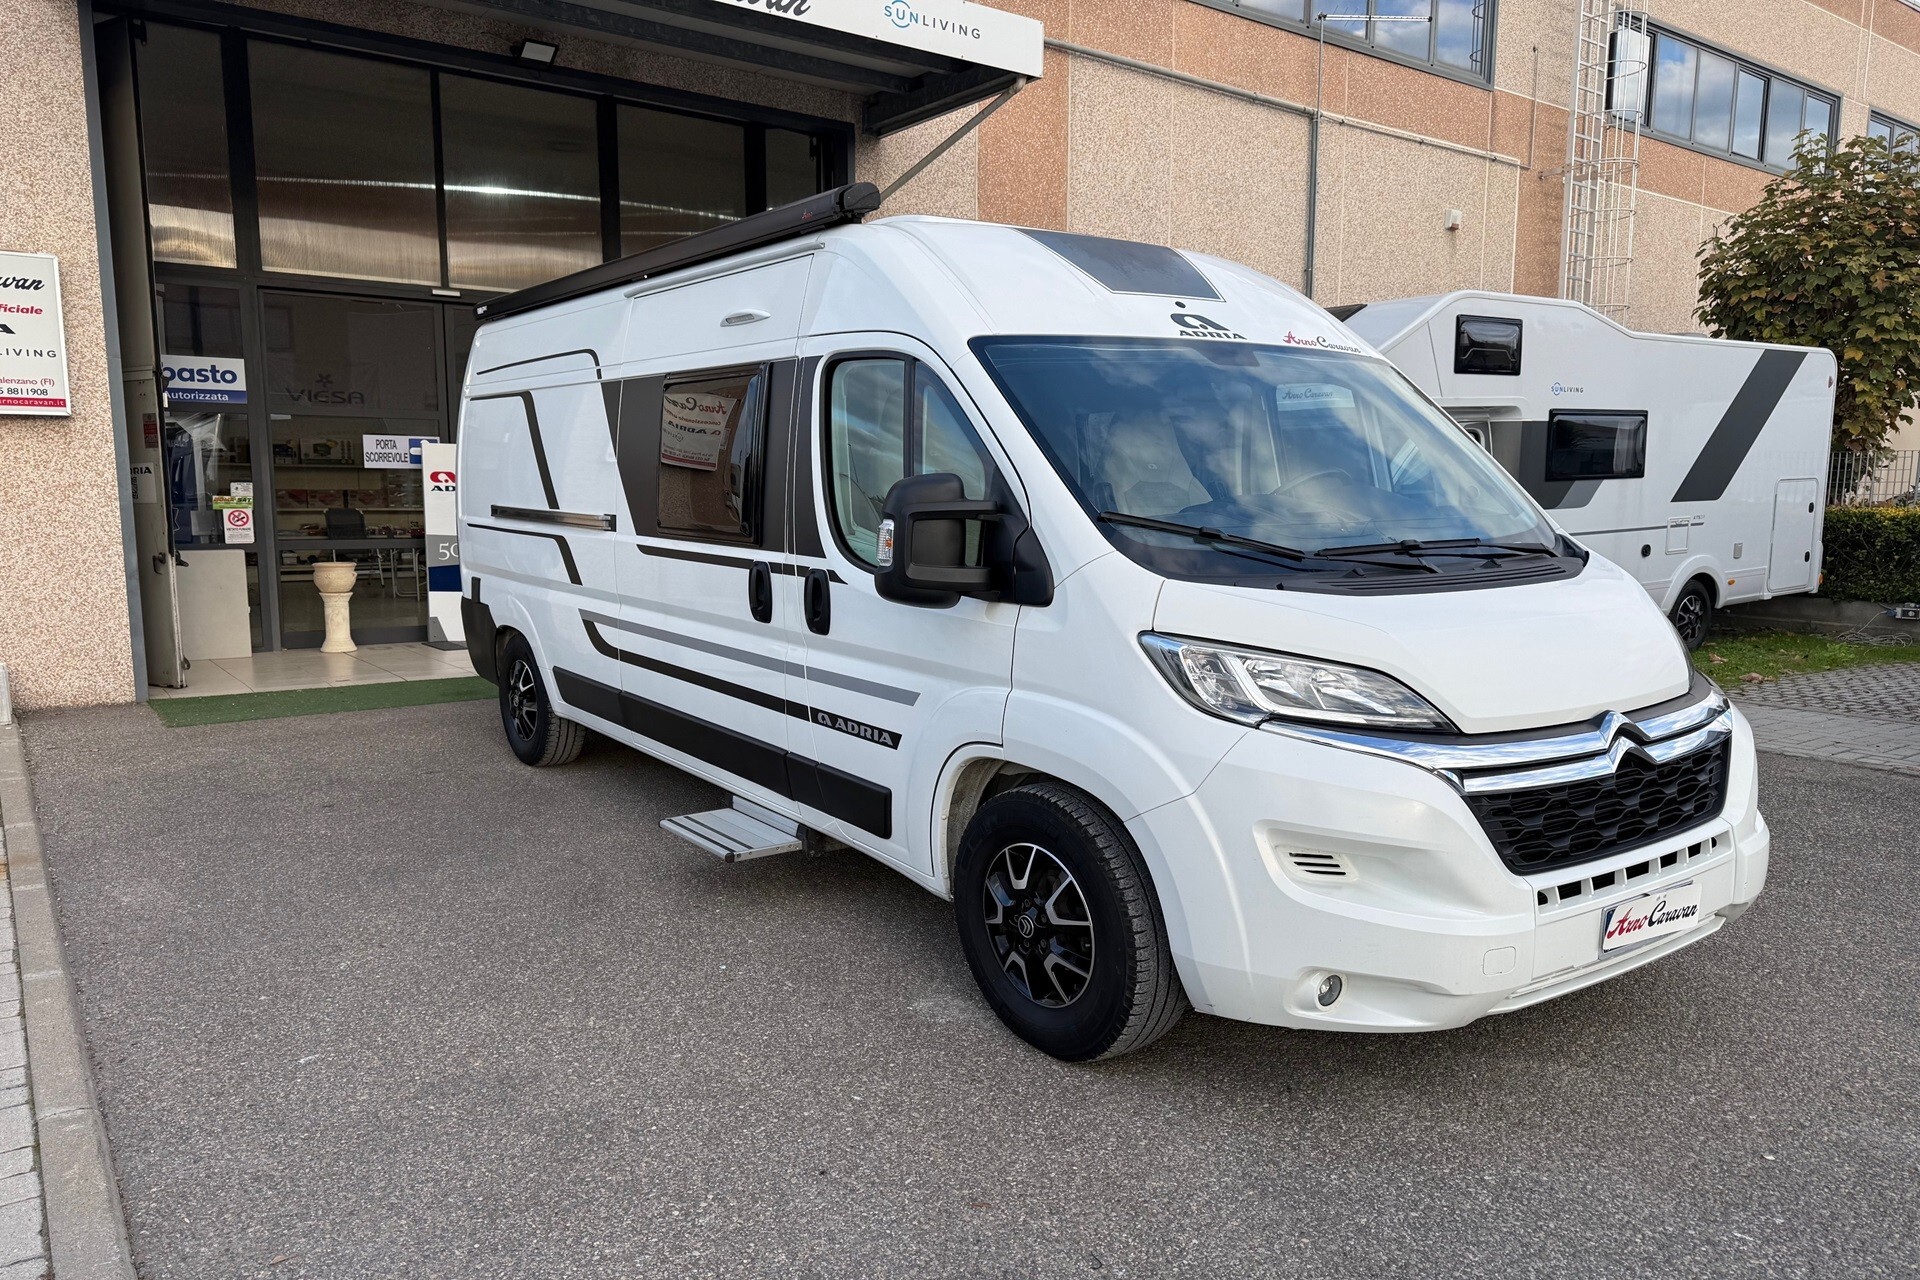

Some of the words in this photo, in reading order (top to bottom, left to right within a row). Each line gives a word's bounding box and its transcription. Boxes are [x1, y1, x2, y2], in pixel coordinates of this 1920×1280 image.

[884, 5, 981, 39] SUNLIVING
[0, 276, 45, 290] van
[1179, 330, 1248, 340] ADRIA
[1283, 331, 1317, 347] Arno
[1316, 336, 1361, 353] Caravan
[0, 348, 57, 358] IVING
[40, 378, 55, 387] (FI)
[7, 387, 48, 396] 8811908
[1551, 384, 1584, 394] SUNLIVING
[165, 391, 229, 401] Autorizzata
[285, 387, 365, 404] VIESA
[376, 439, 397, 450] PORTA
[365, 452, 408, 463] SCORREVOLE
[835, 718, 893, 746] ADRIA
[1607, 907, 1649, 939] Arno
[1648, 900, 1698, 927] Caravan
